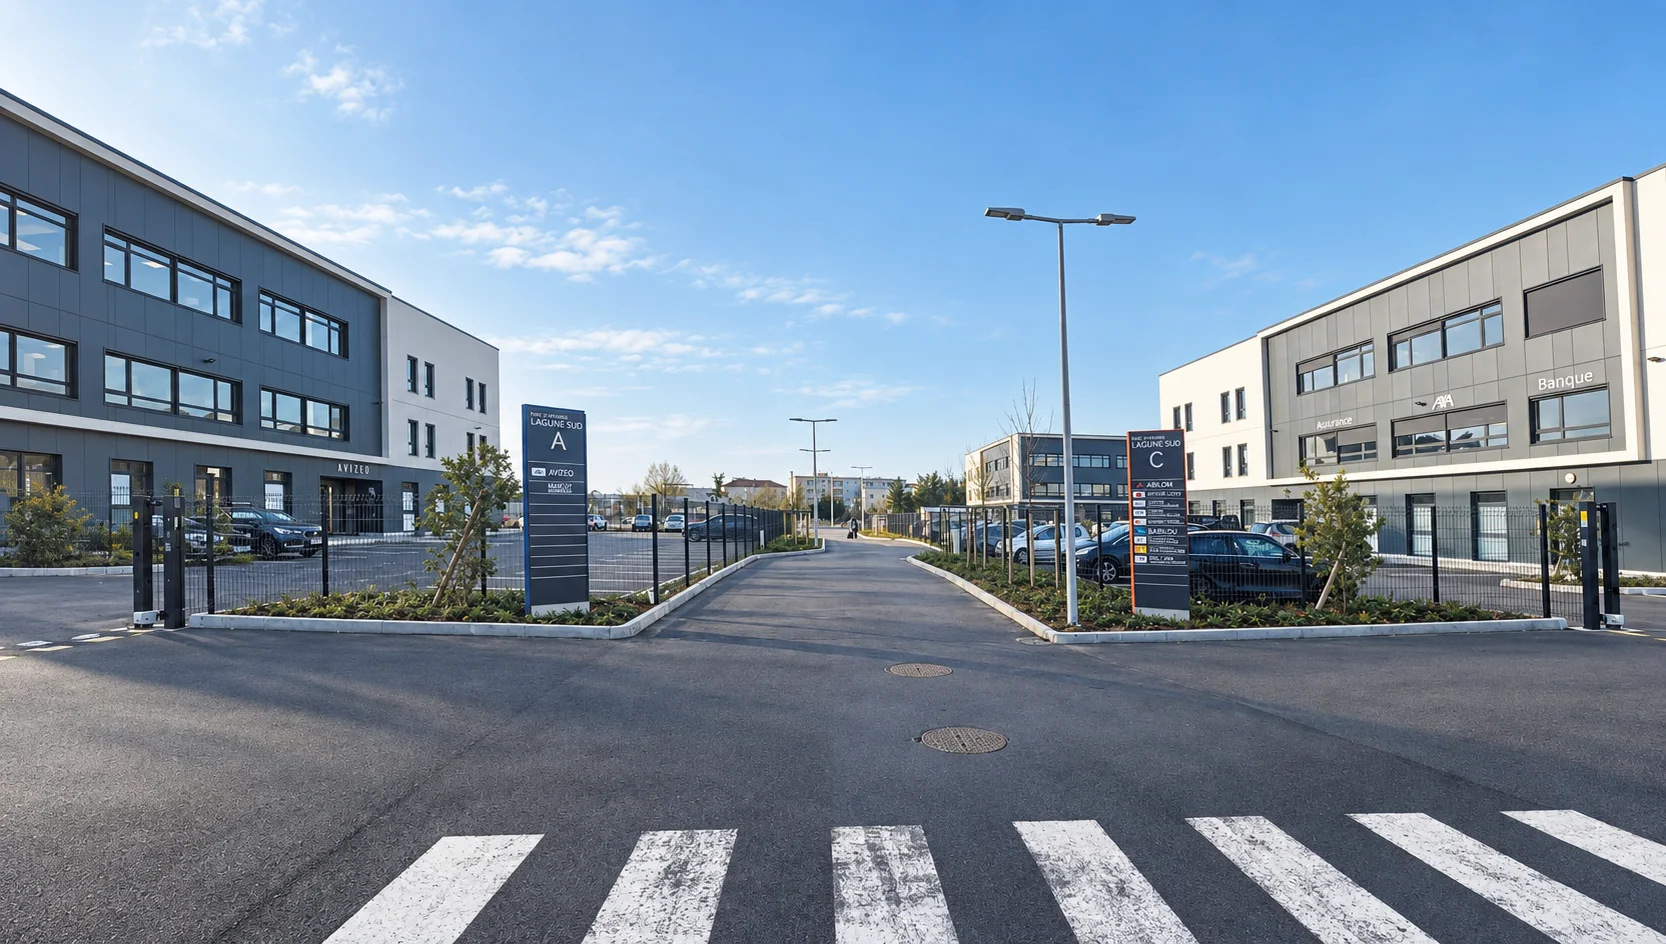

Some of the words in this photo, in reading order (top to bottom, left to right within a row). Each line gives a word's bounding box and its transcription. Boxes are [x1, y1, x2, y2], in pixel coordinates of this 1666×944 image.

[1538, 371, 1594, 391] Banque
[1431, 394, 1454, 410] AXA
[530, 417, 565, 429] LAGUNE
[566, 421, 583, 430] SUD
[550, 431, 567, 451] A
[1131, 440, 1164, 449] LAGUNE
[1149, 450, 1164, 468] C
